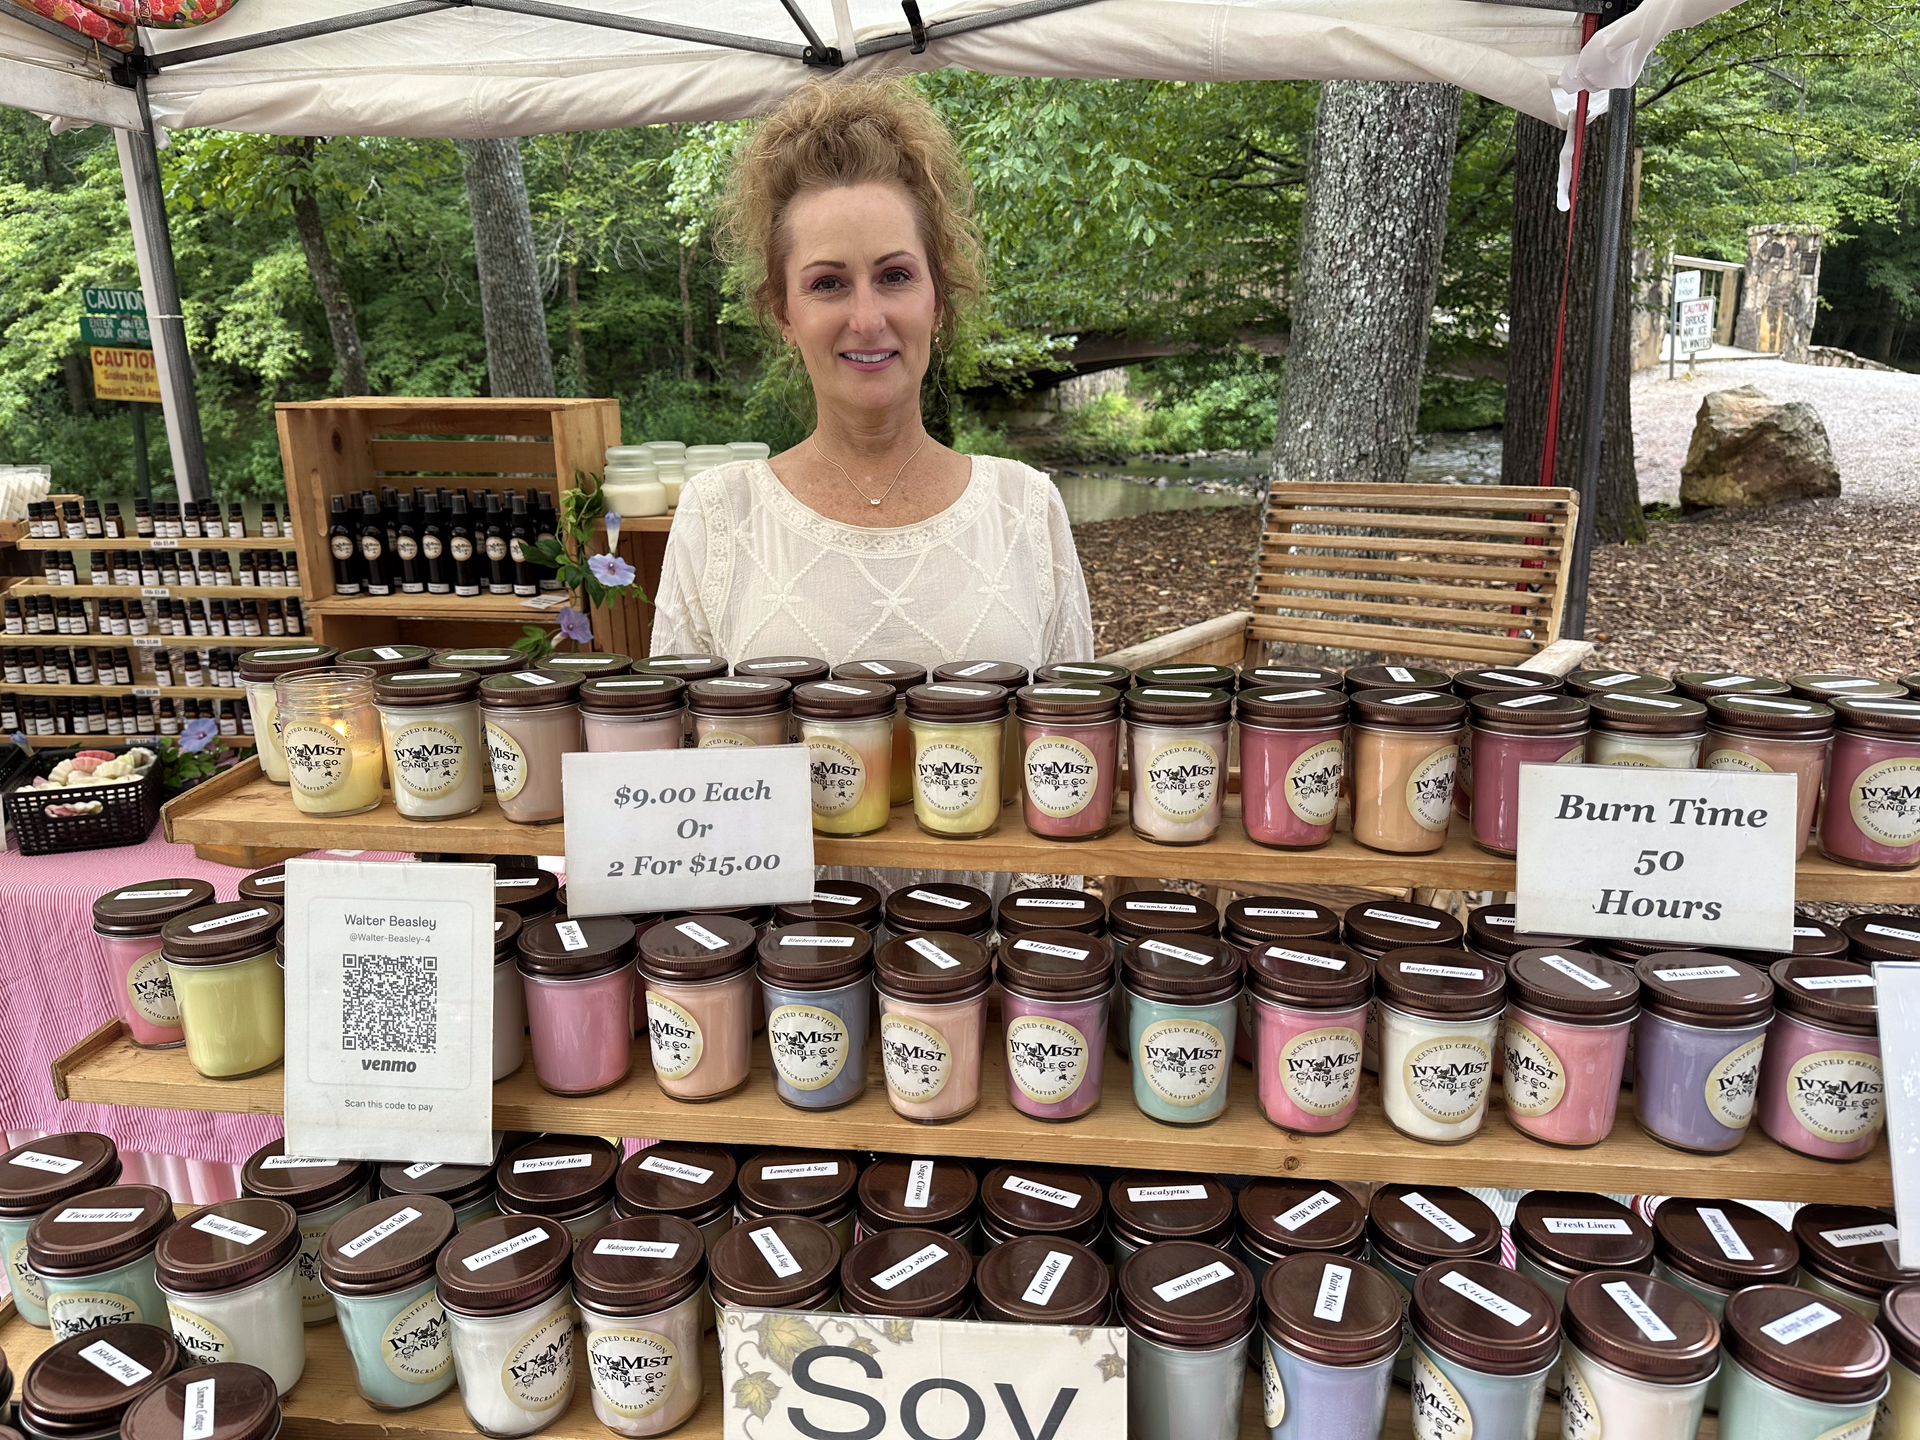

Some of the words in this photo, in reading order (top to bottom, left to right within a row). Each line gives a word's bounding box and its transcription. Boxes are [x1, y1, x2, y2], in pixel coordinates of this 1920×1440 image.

[86, 289, 145, 311] CAUTION
[1684, 302, 1709, 314] CAUTION
[89, 318, 114, 328] ENTER
[121, 319, 145, 329] WATER
[1685, 314, 1707, 326] BRIDGE
[92, 329, 114, 338] YOUR
[1683, 327, 1694, 337] MAY
[1698, 326, 1707, 335] ICE
[1690, 338, 1712, 348] WINTER
[614, 784, 696, 809] $9.00
[702, 780, 772, 802] Each
[1554, 794, 1657, 823] Burn
[1669, 797, 1768, 828] Time
[677, 818, 714, 839] Or
[607, 861, 624, 877] 2
[631, 855, 683, 876] For
[689, 852, 781, 877] $15.00
[1633, 850, 1684, 876] 50
[917, 892, 939, 901] Ginger
[1595, 889, 1722, 921] Hours
[344, 914, 386, 926] Walter
[389, 915, 437, 930] Beasley
[1369, 911, 1400, 921] Raspberry
[1400, 916, 1431, 926] Lemonade
[349, 933, 431, 944] @Walter-Beasley-4
[915, 940, 934, 954] Ginger
[1026, 943, 1079, 956] Mulberry
[1150, 943, 1182, 956] Cucumber
[1182, 952, 1203, 962] Melon
[1281, 951, 1303, 960] Fruit
[1304, 955, 1332, 966] Slices
[1406, 966, 1439, 975] Raspberry
[1441, 968, 1476, 977] Lemonade
[1667, 968, 1726, 978] Muscadine
[1147, 1027, 1180, 1045] SCENTED
[1183, 1027, 1219, 1048] CREATION
[361, 1059, 417, 1073] venmo
[1150, 1074, 1196, 1101] HANDCRAFTED
[344, 1099, 366, 1108] Scan
[368, 1100, 383, 1109] this
[385, 1100, 405, 1110] code
[407, 1102, 416, 1110] to
[418, 1102, 434, 1112] pay
[43, 1159, 67, 1167] Mist
[521, 1161, 539, 1170] Very
[539, 1160, 555, 1168] Sexy
[555, 1159, 567, 1167] for
[650, 1161, 676, 1173] Mahogany
[675, 1168, 702, 1178] Teakwood
[769, 1166, 806, 1174] Lemongrass
[917, 1163, 929, 1180] Sage
[914, 1180, 926, 1201] Citrus
[1015, 1181, 1068, 1201] Lavender
[1139, 1188, 1190, 1197] Eucalyptus
[1309, 1196, 1330, 1210] Rain
[67, 1211, 104, 1219] Tuscan
[105, 1211, 133, 1219] Herb
[1290, 1208, 1311, 1222] Mist
[1415, 1202, 1456, 1231] Kudzu
[203, 1219, 229, 1231] Sweater
[229, 1226, 252, 1239] Weather
[349, 1236, 375, 1251] Cactus
[373, 1229, 383, 1238] &
[380, 1221, 396, 1233] Sea
[391, 1212, 410, 1224] Salt
[1556, 1221, 1584, 1229] Fresh
[1587, 1221, 1616, 1229] Linen
[1834, 1228, 1885, 1242] Honeysuckle
[474, 1253, 492, 1264] Very
[493, 1244, 509, 1257] Sexy
[510, 1240, 521, 1251] for
[521, 1234, 538, 1244] Men
[606, 1243, 635, 1253] Mahogany
[636, 1245, 667, 1253] Teakwood
[760, 1232, 781, 1257] Lemongrass
[777, 1258, 790, 1269] Sage
[914, 1250, 936, 1266] Sage
[885, 1264, 914, 1283] Citrus
[1032, 1259, 1061, 1295] Lavender
[1172, 1269, 1221, 1292] Eucalyptus
[1328, 1272, 1343, 1291] Rain
[1323, 1291, 1338, 1311] Mist
[1458, 1282, 1508, 1312] Kudzu
[1619, 1289, 1642, 1309] Fresh
[1636, 1310, 1660, 1331] Linen
[92, 1348, 121, 1367] Forest
[118, 1363, 141, 1379] Pine
[196, 1386, 209, 1409] Summer
[191, 1409, 208, 1431] Cottage
